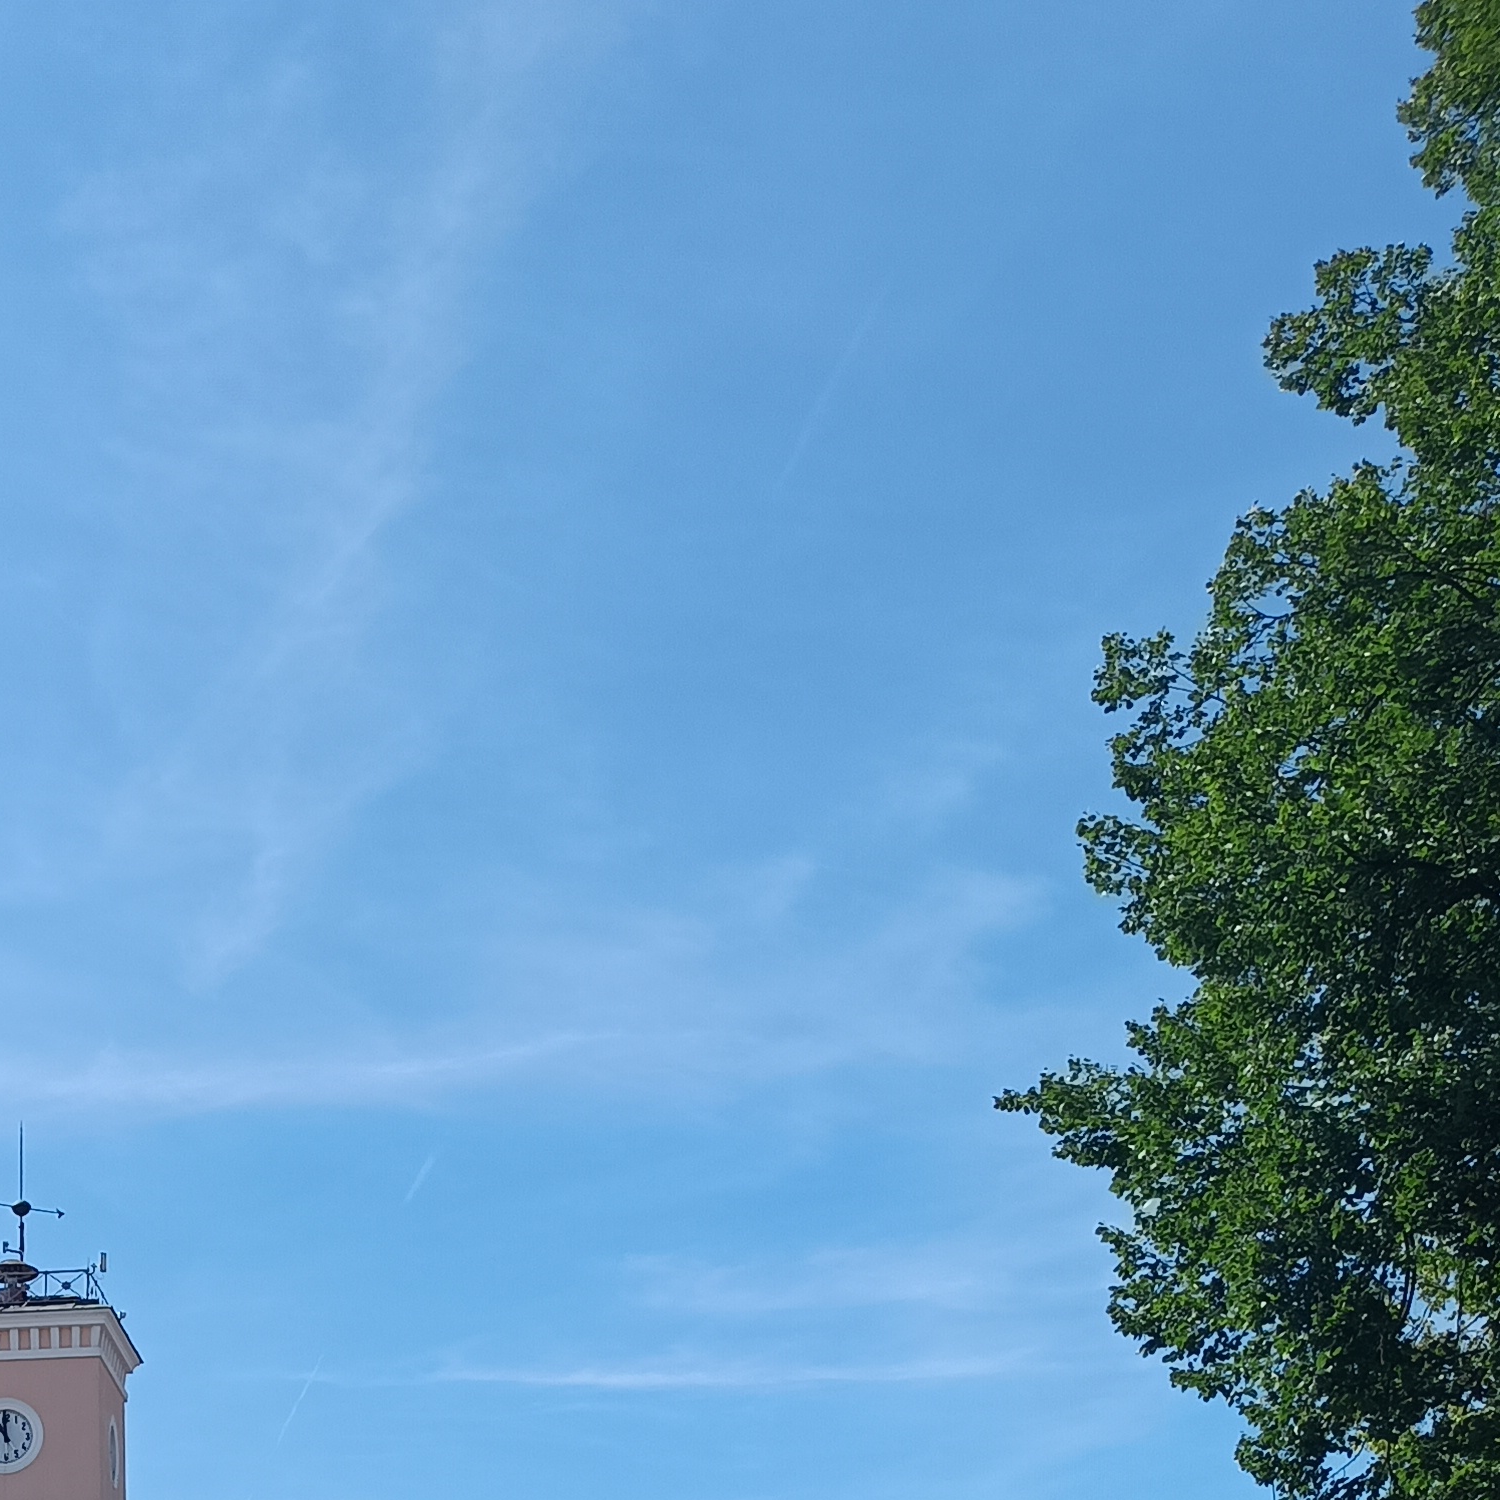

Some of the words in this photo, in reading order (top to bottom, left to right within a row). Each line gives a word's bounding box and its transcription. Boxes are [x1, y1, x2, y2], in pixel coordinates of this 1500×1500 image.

[21, 1421, 26, 1431] 2
[25, 1432, 30, 1441] 3
[21, 1442, 27, 1451] 4
[4, 1452, 9, 1461] 6
[14, 1449, 19, 1458] 5
